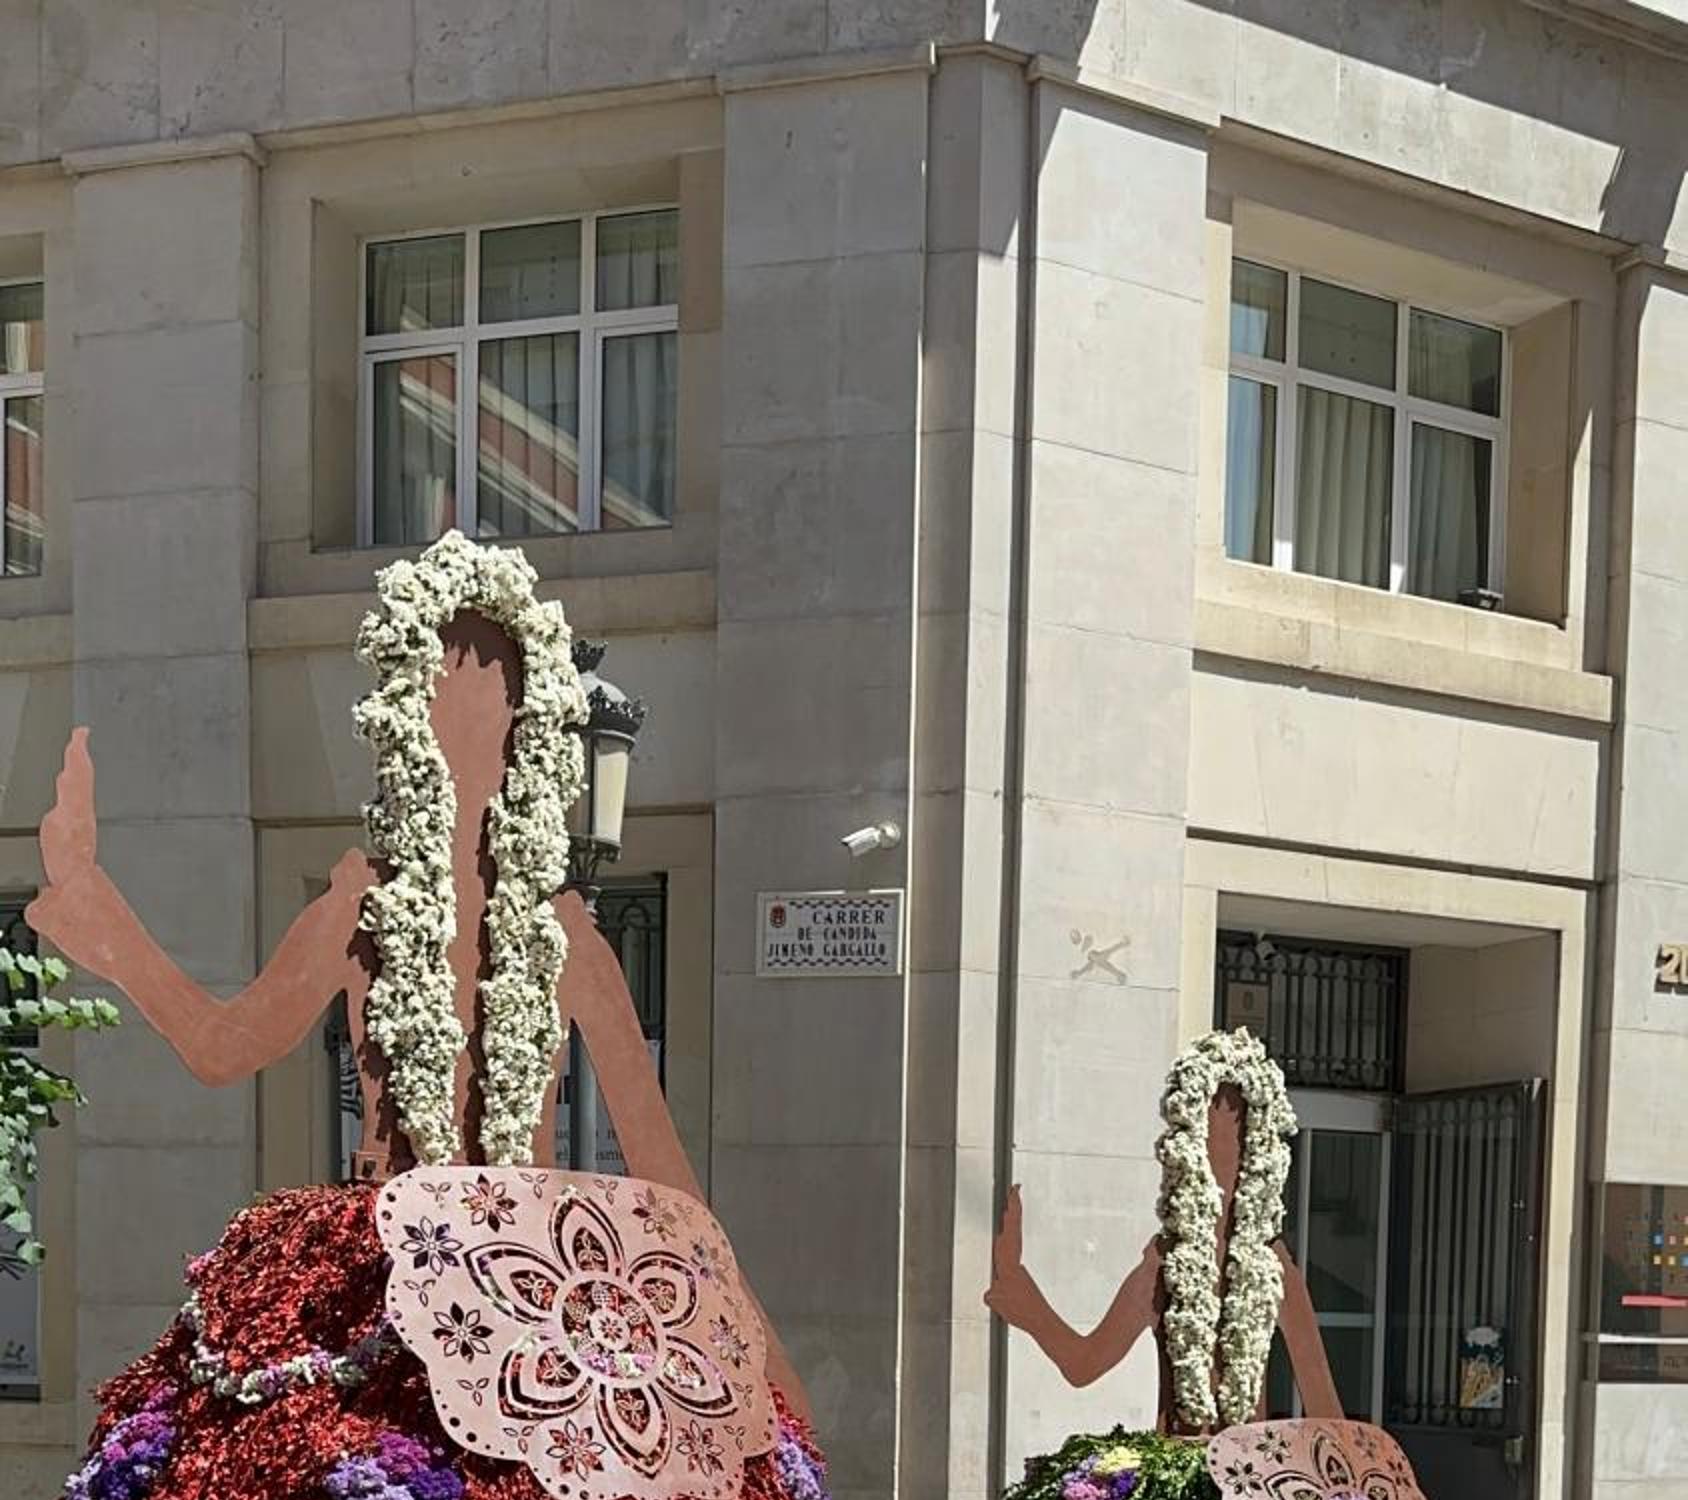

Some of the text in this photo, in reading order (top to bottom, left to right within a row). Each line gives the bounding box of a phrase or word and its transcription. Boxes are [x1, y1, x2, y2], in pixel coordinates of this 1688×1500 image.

[813, 909, 886, 925] CARRER
[797, 927, 812, 940] DE
[768, 943, 886, 957] JIMENO GARGALLO
